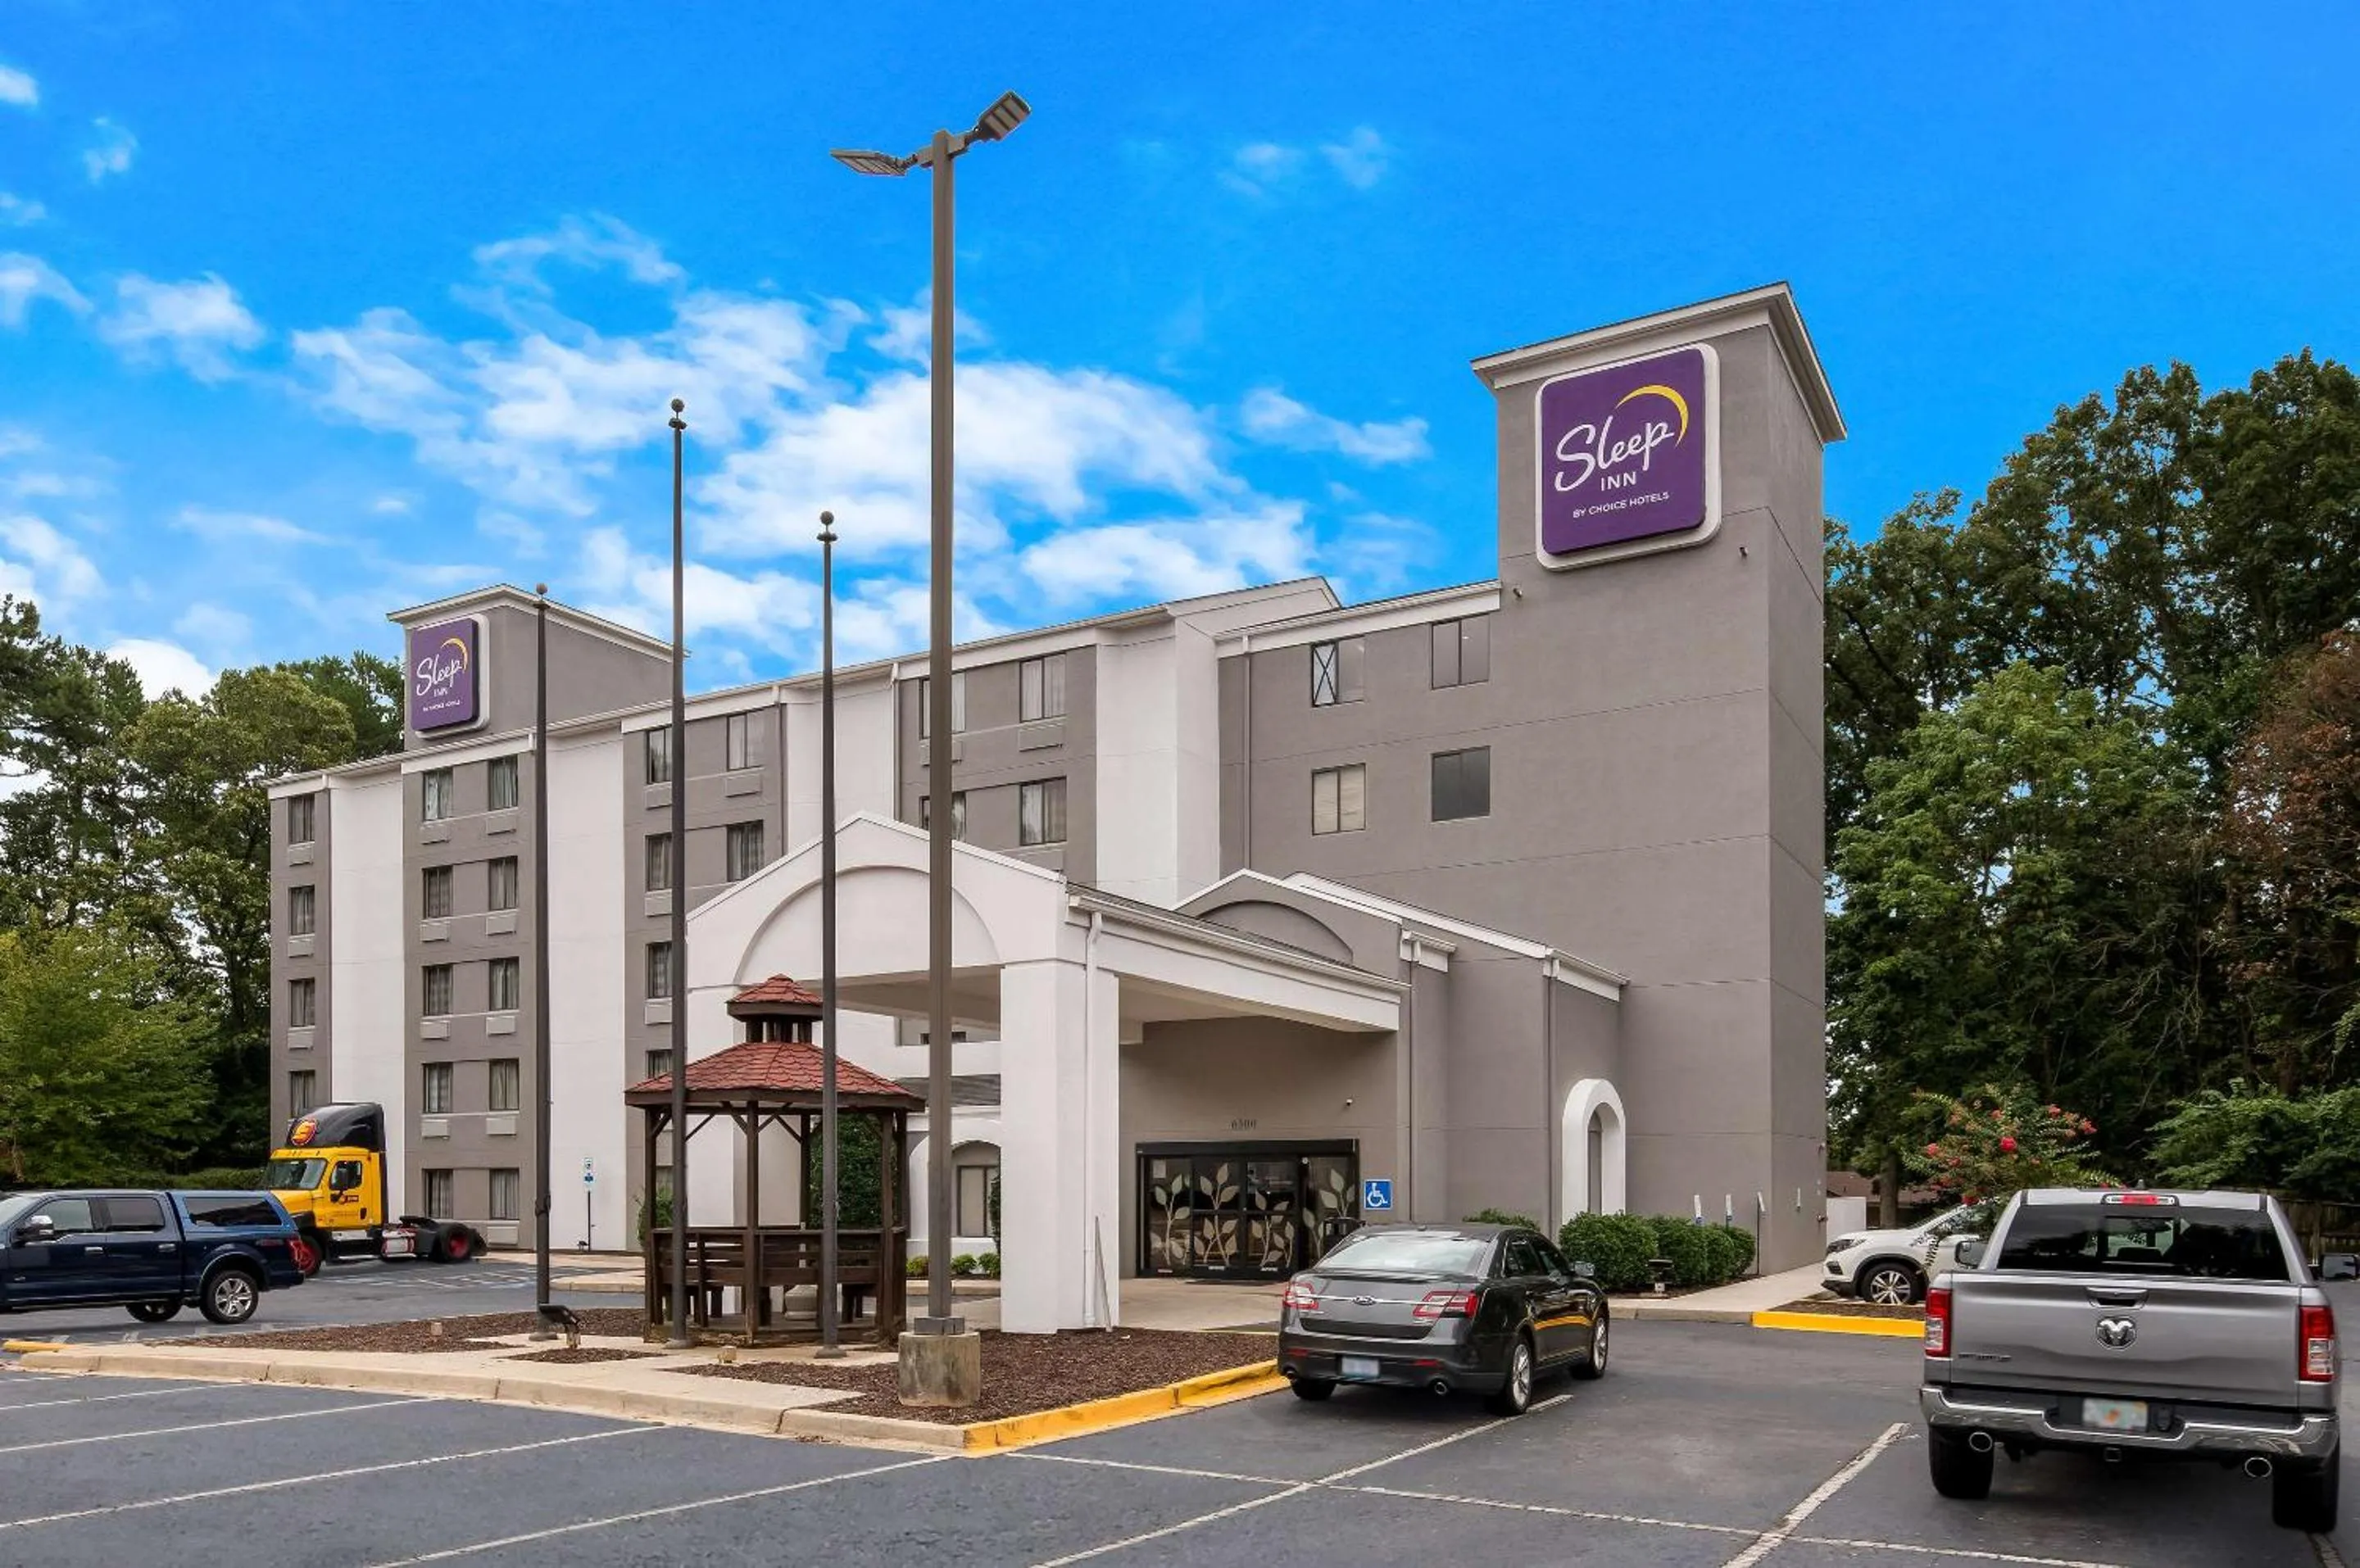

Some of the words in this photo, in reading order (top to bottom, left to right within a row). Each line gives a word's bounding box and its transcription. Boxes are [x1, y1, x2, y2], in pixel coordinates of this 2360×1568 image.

[1554, 415, 1675, 492] Sleep
[1600, 471, 1637, 492] INN
[1573, 508, 1586, 519] BY
[1588, 499, 1627, 515] CHOICE
[1629, 492, 1670, 506] HOTELS
[416, 654, 462, 696] Sleep
